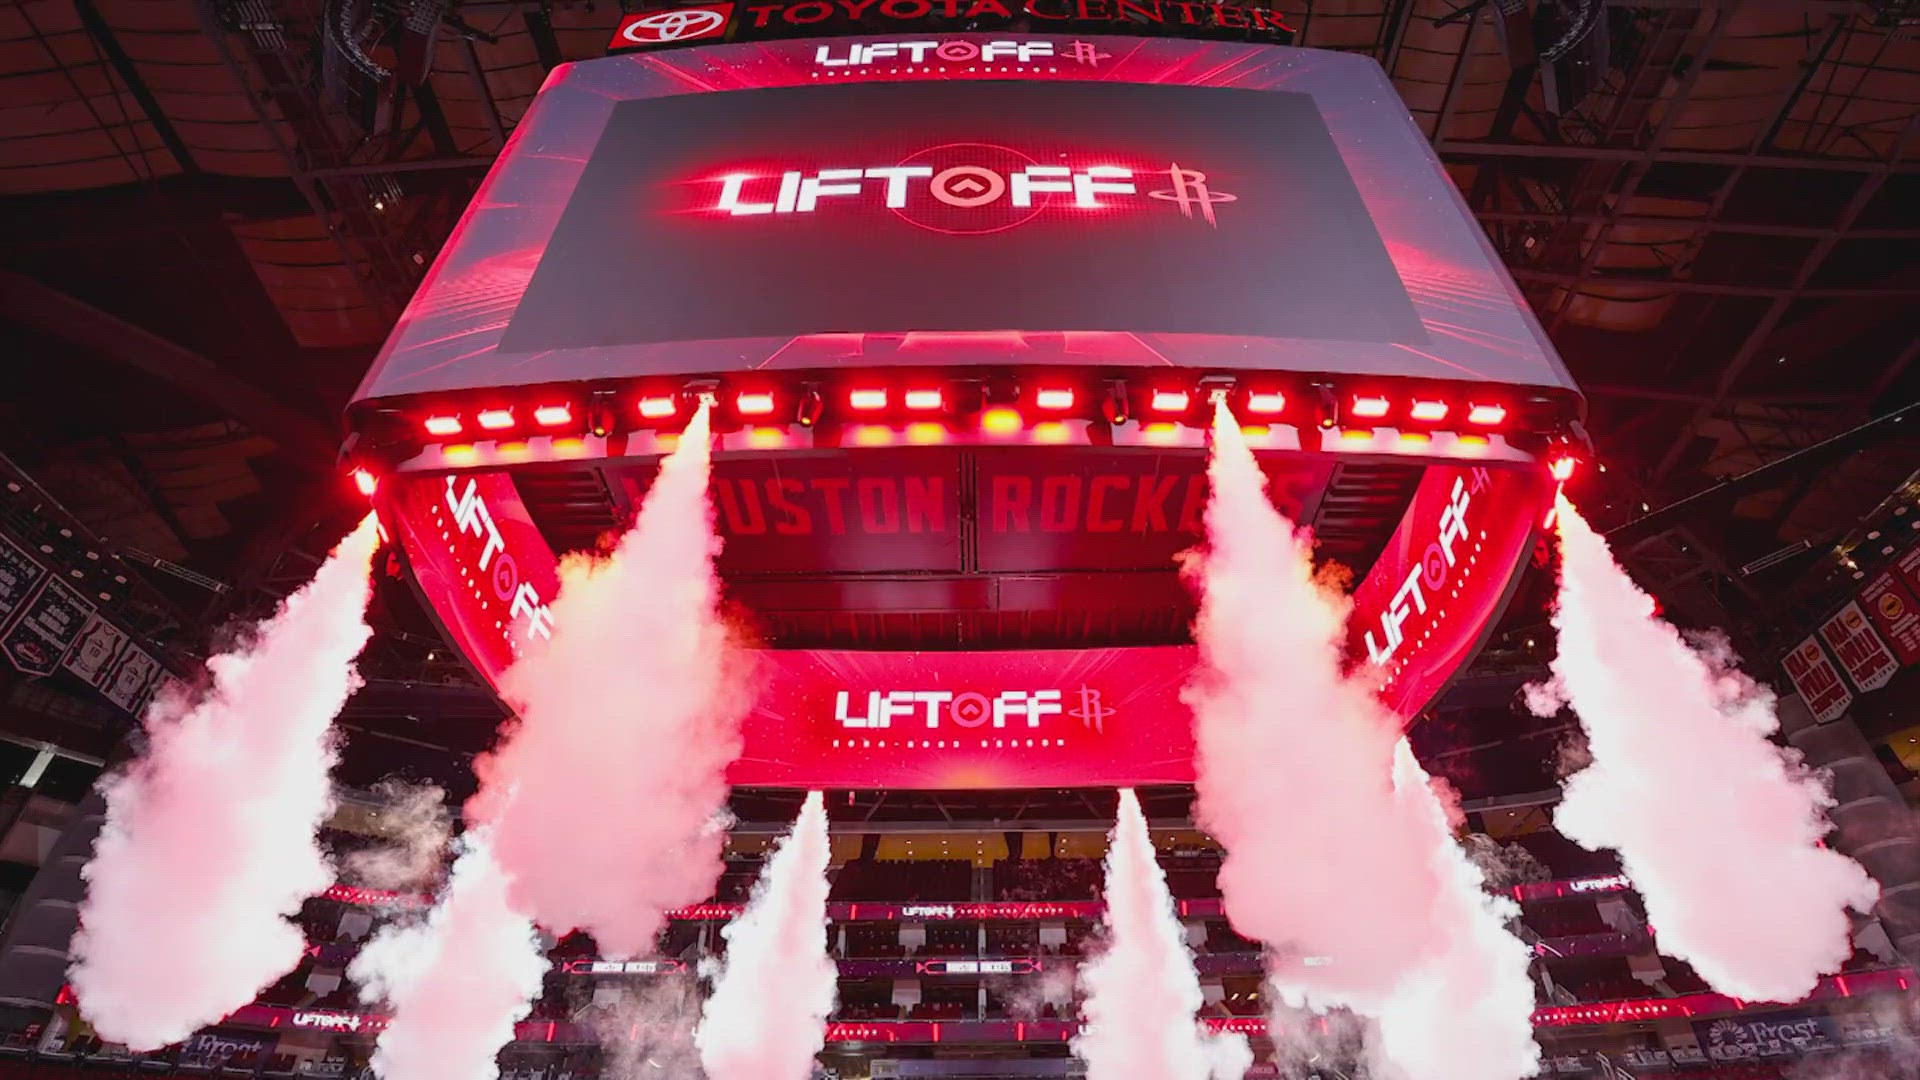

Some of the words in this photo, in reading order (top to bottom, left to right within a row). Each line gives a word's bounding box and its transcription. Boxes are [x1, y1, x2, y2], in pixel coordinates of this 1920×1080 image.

[748, 0, 1012, 27] TOYOTA
[1024, 0, 1297, 33] CENTER
[815, 41, 1054, 66] LIFTOFF
[719, 166, 1136, 215] LIFTOFF
[1364, 475, 1471, 666] LIFTOFF
[835, 690, 1062, 728] LIFTOFF
